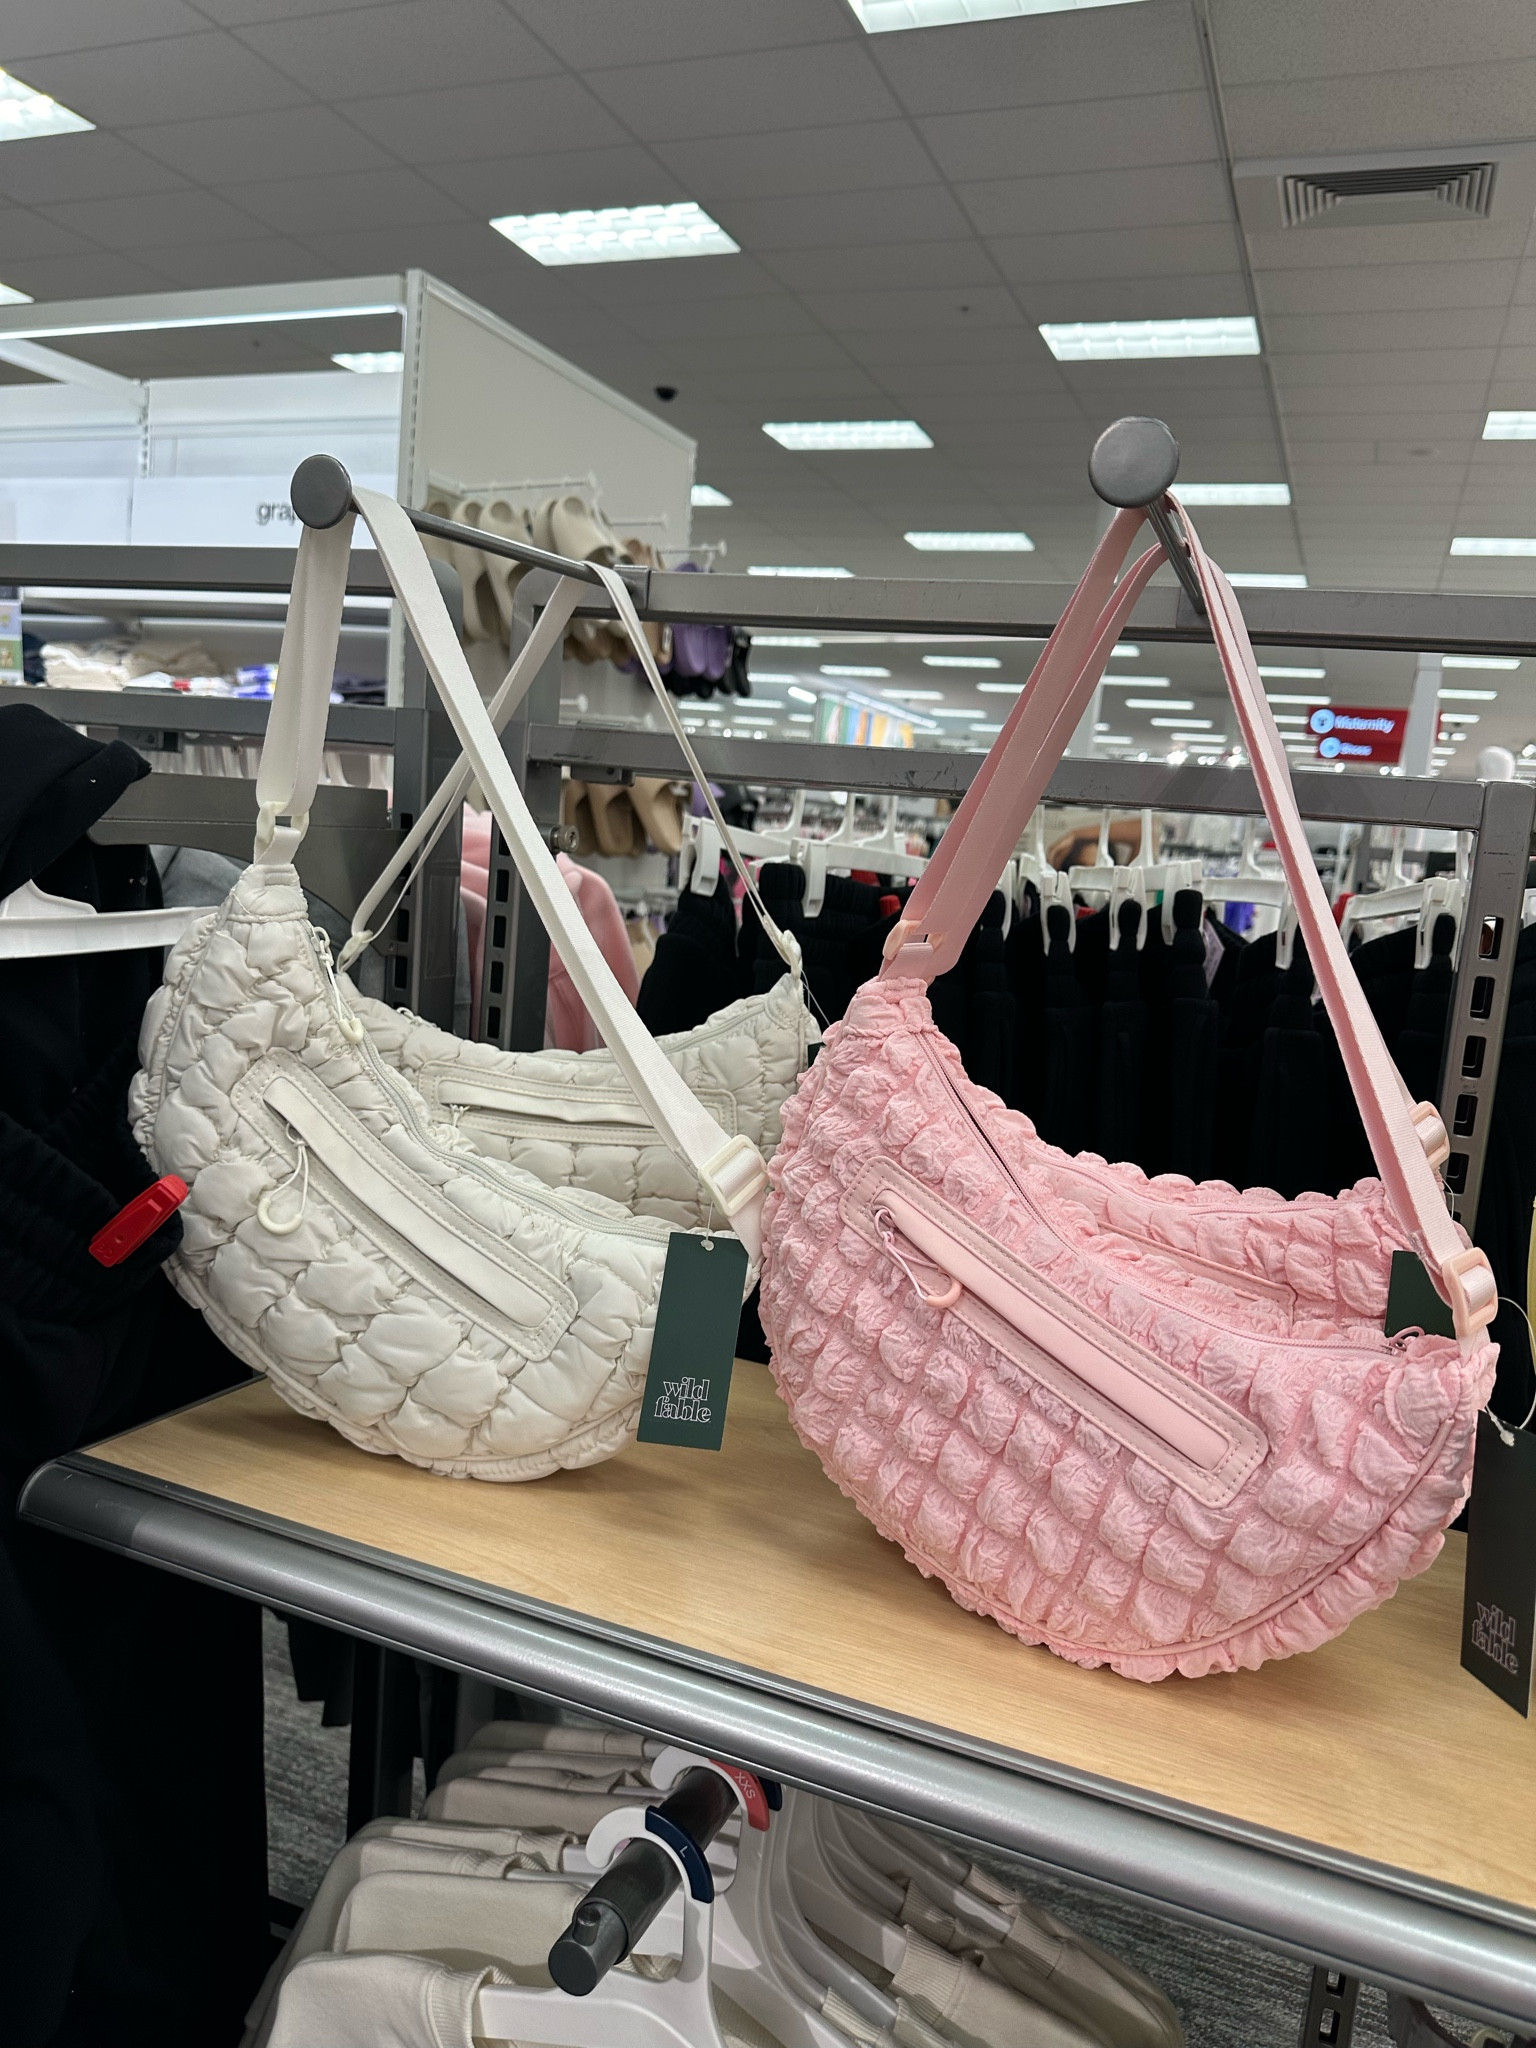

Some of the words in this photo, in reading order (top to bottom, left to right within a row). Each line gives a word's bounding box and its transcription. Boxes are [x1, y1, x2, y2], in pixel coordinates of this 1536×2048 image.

[1335, 715, 1396, 734] Maternity
[662, 1376, 711, 1401] wild
[653, 1395, 712, 1423] fable
[1476, 1601, 1516, 1646] wild
[1471, 1619, 1519, 1675] fable
[734, 1772, 756, 1799] XXS
[679, 1845, 688, 1858] L
